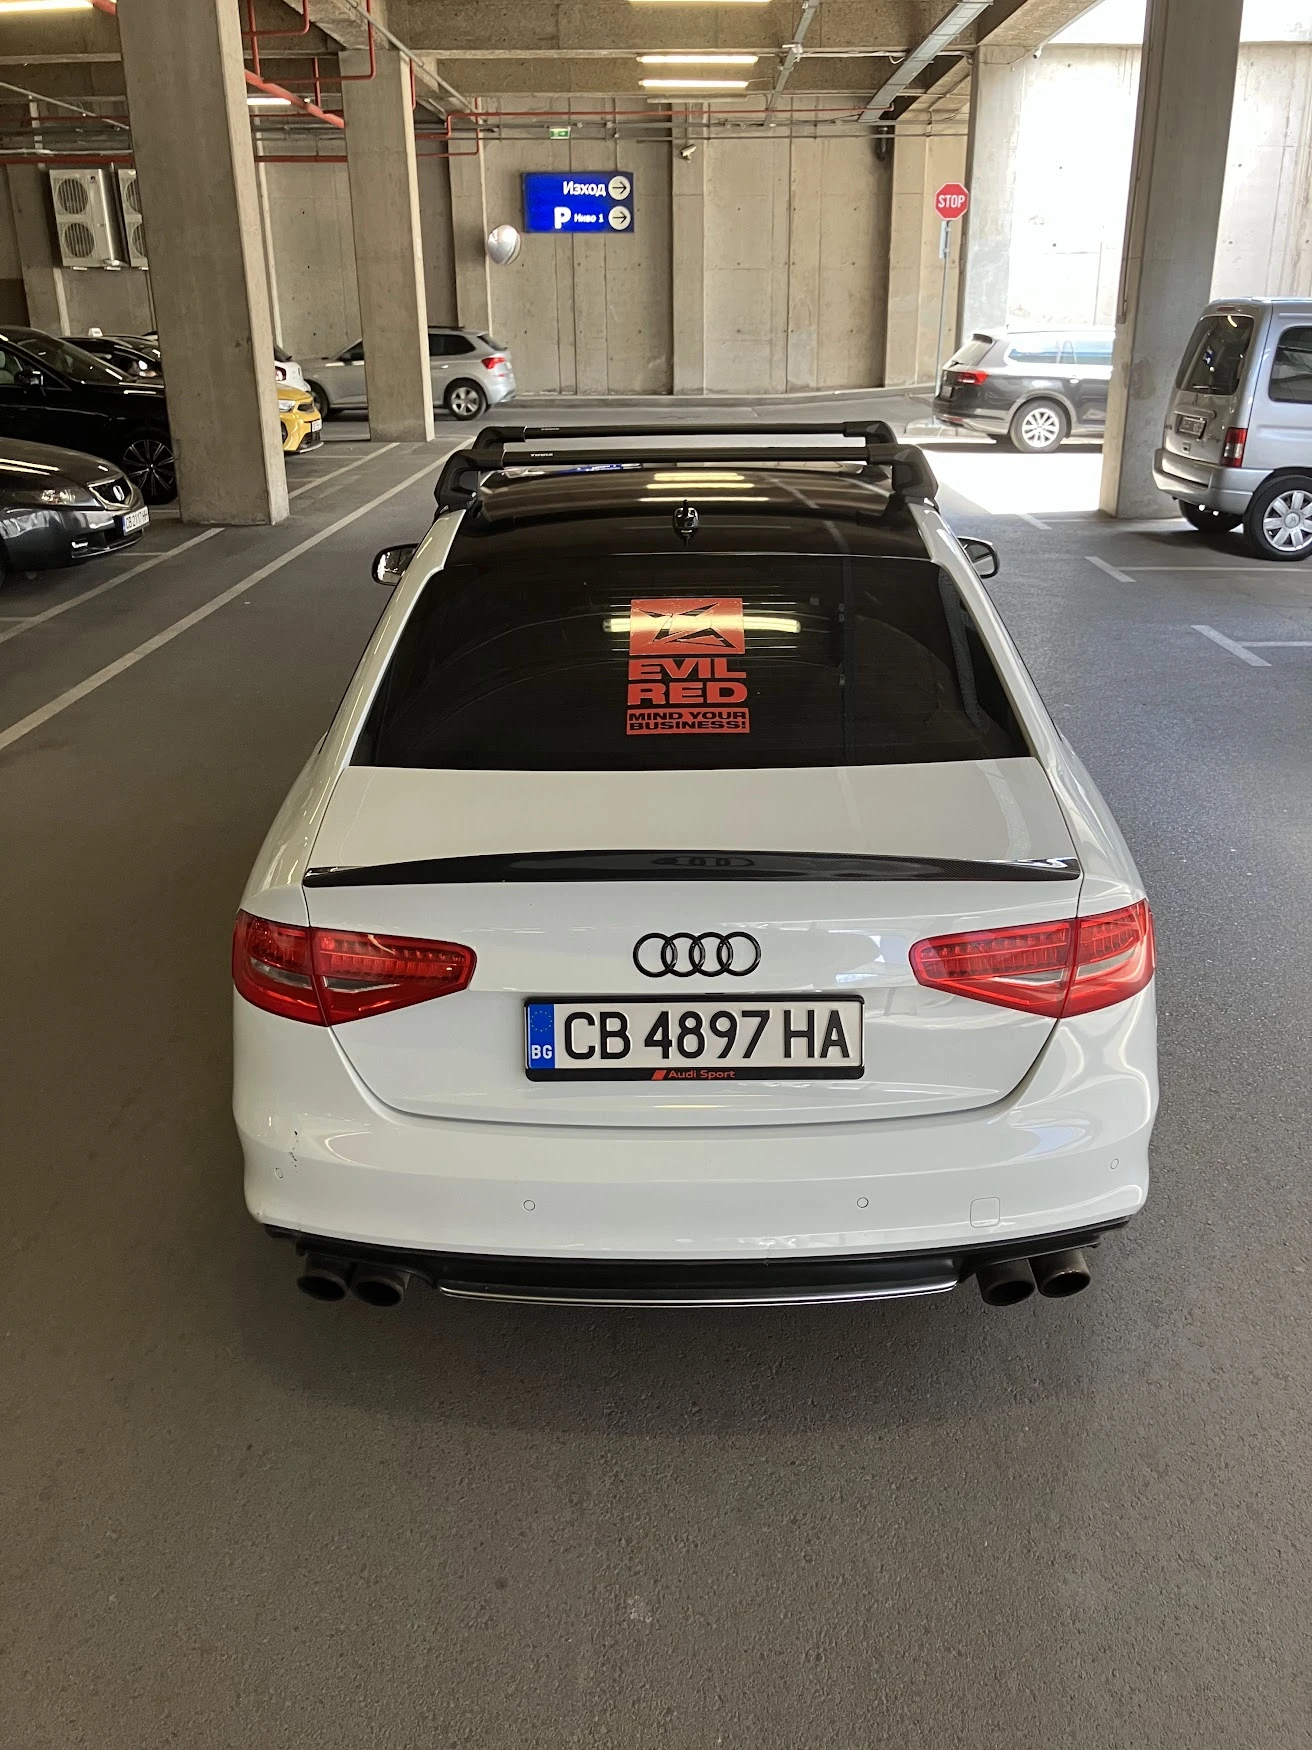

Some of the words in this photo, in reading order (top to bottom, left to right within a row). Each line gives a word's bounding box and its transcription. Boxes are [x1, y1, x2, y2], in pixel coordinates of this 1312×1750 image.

[562, 181, 606, 197] Изход
[938, 194, 965, 208] STOP
[553, 206, 572, 230] P
[574, 213, 597, 223] Ниво
[599, 213, 604, 223] 1
[628, 657, 747, 681] EVIL
[627, 681, 748, 706] RED
[629, 712, 684, 722] MIND
[687, 711, 747, 720] YOUR
[629, 720, 746, 731] BUSINESS!
[531, 1045, 553, 1060] BG
[564, 1011, 631, 1060] CB
[643, 1009, 771, 1060] 4897
[783, 1009, 850, 1059] HA
[668, 1070, 698, 1079] Audi
[700, 1069, 736, 1081] Sport
